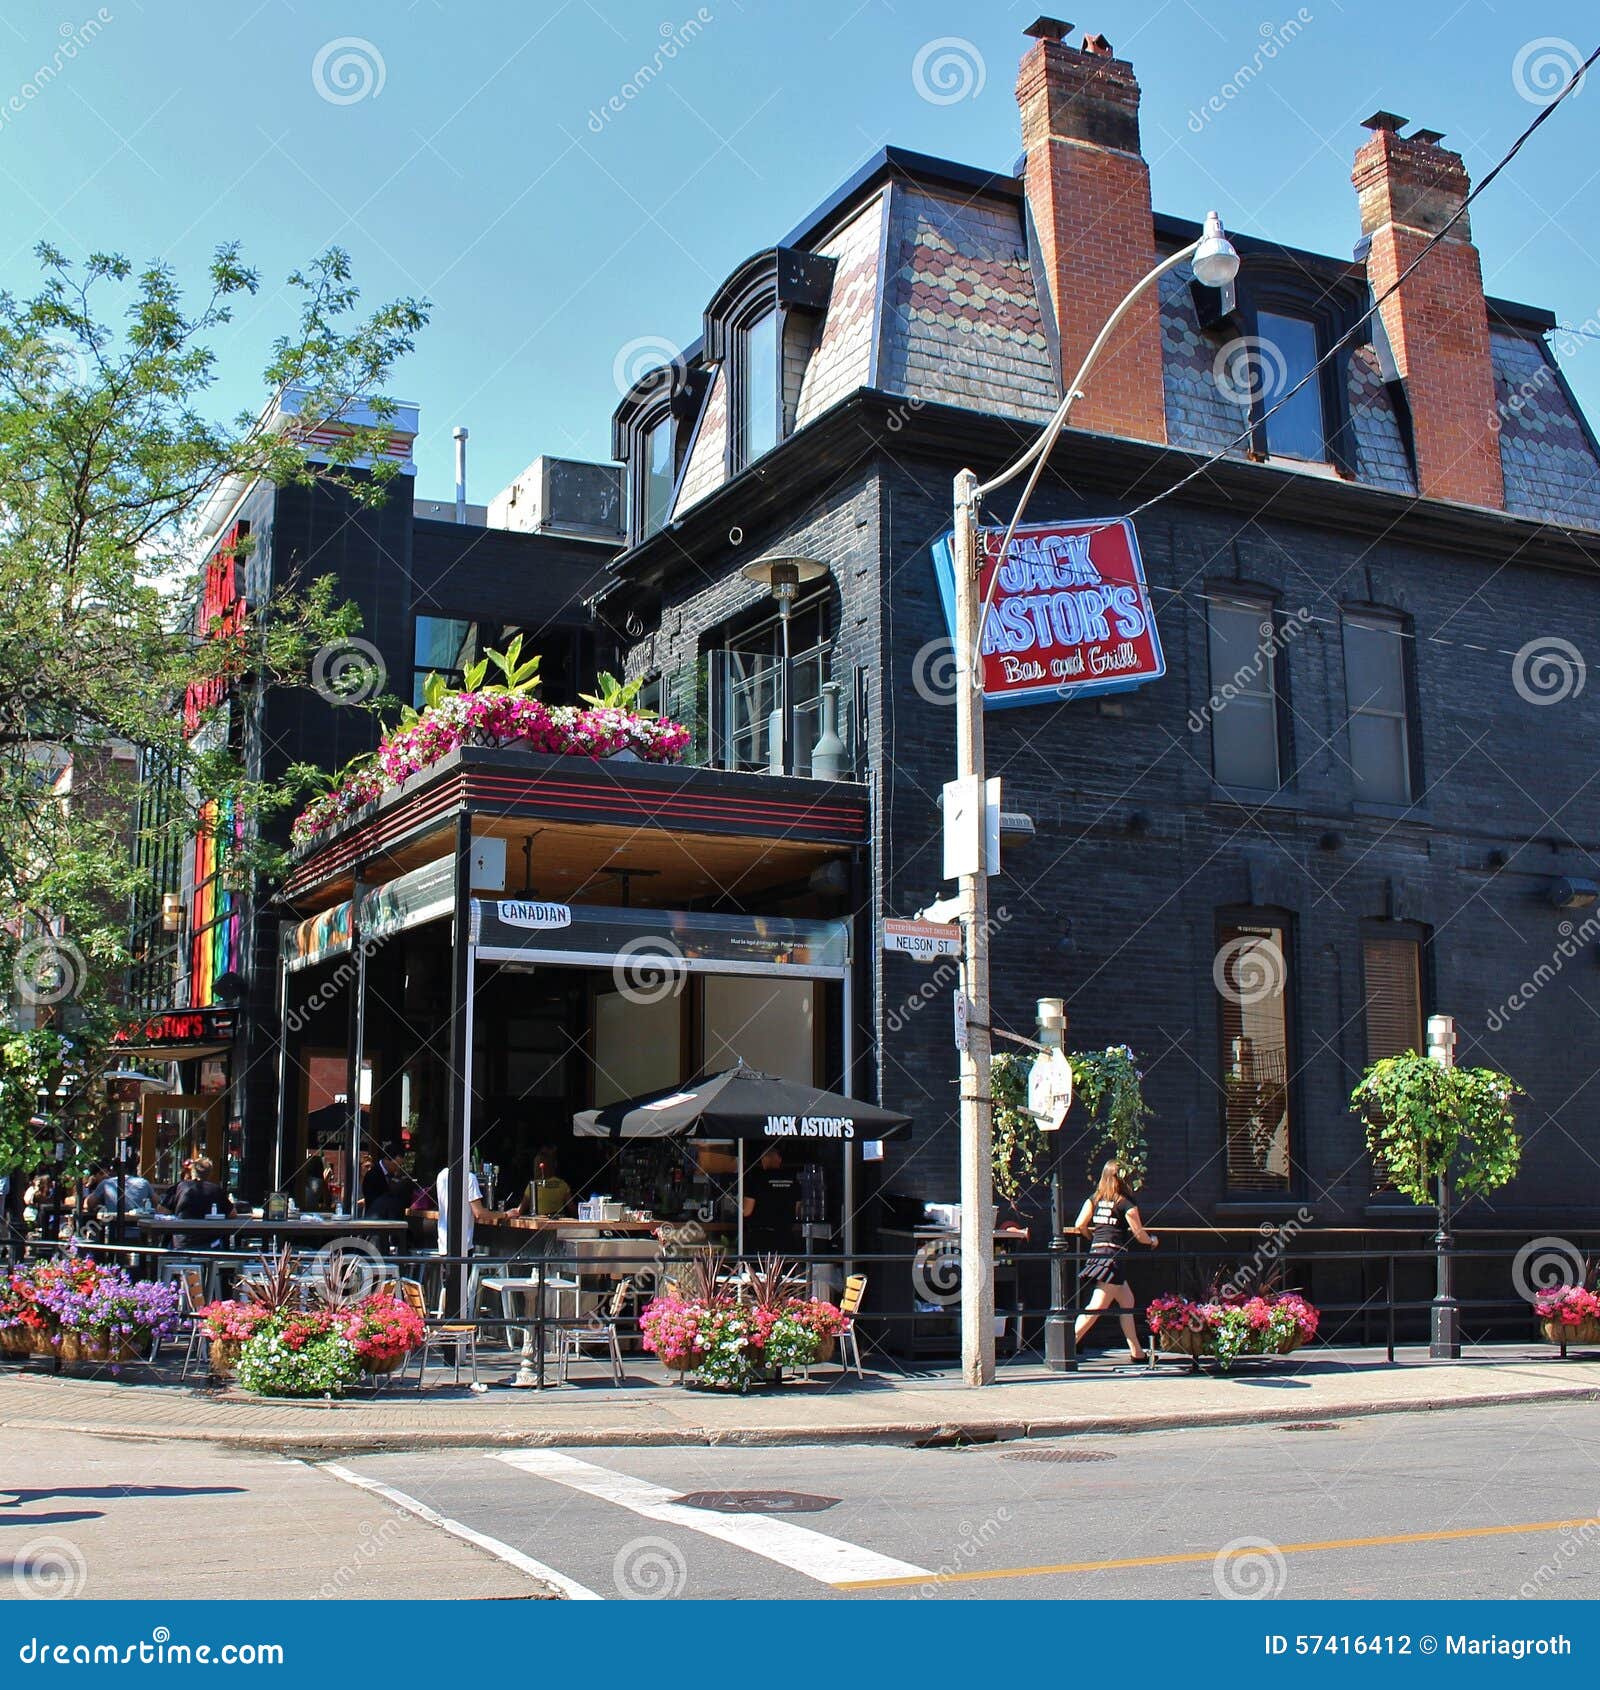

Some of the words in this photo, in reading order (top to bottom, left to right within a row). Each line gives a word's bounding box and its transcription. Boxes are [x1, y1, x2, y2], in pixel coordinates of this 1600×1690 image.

[1000, 535, 1101, 593] JACK
[980, 584, 1146, 656] ASTOR'S
[1000, 653, 1046, 683] Bar
[1050, 648, 1084, 677] and
[502, 903, 566, 922] CANADIAN
[896, 936, 933, 952] NELSON
[764, 1116, 798, 1136] JACK
[800, 1117, 855, 1138] ASTOR'S
